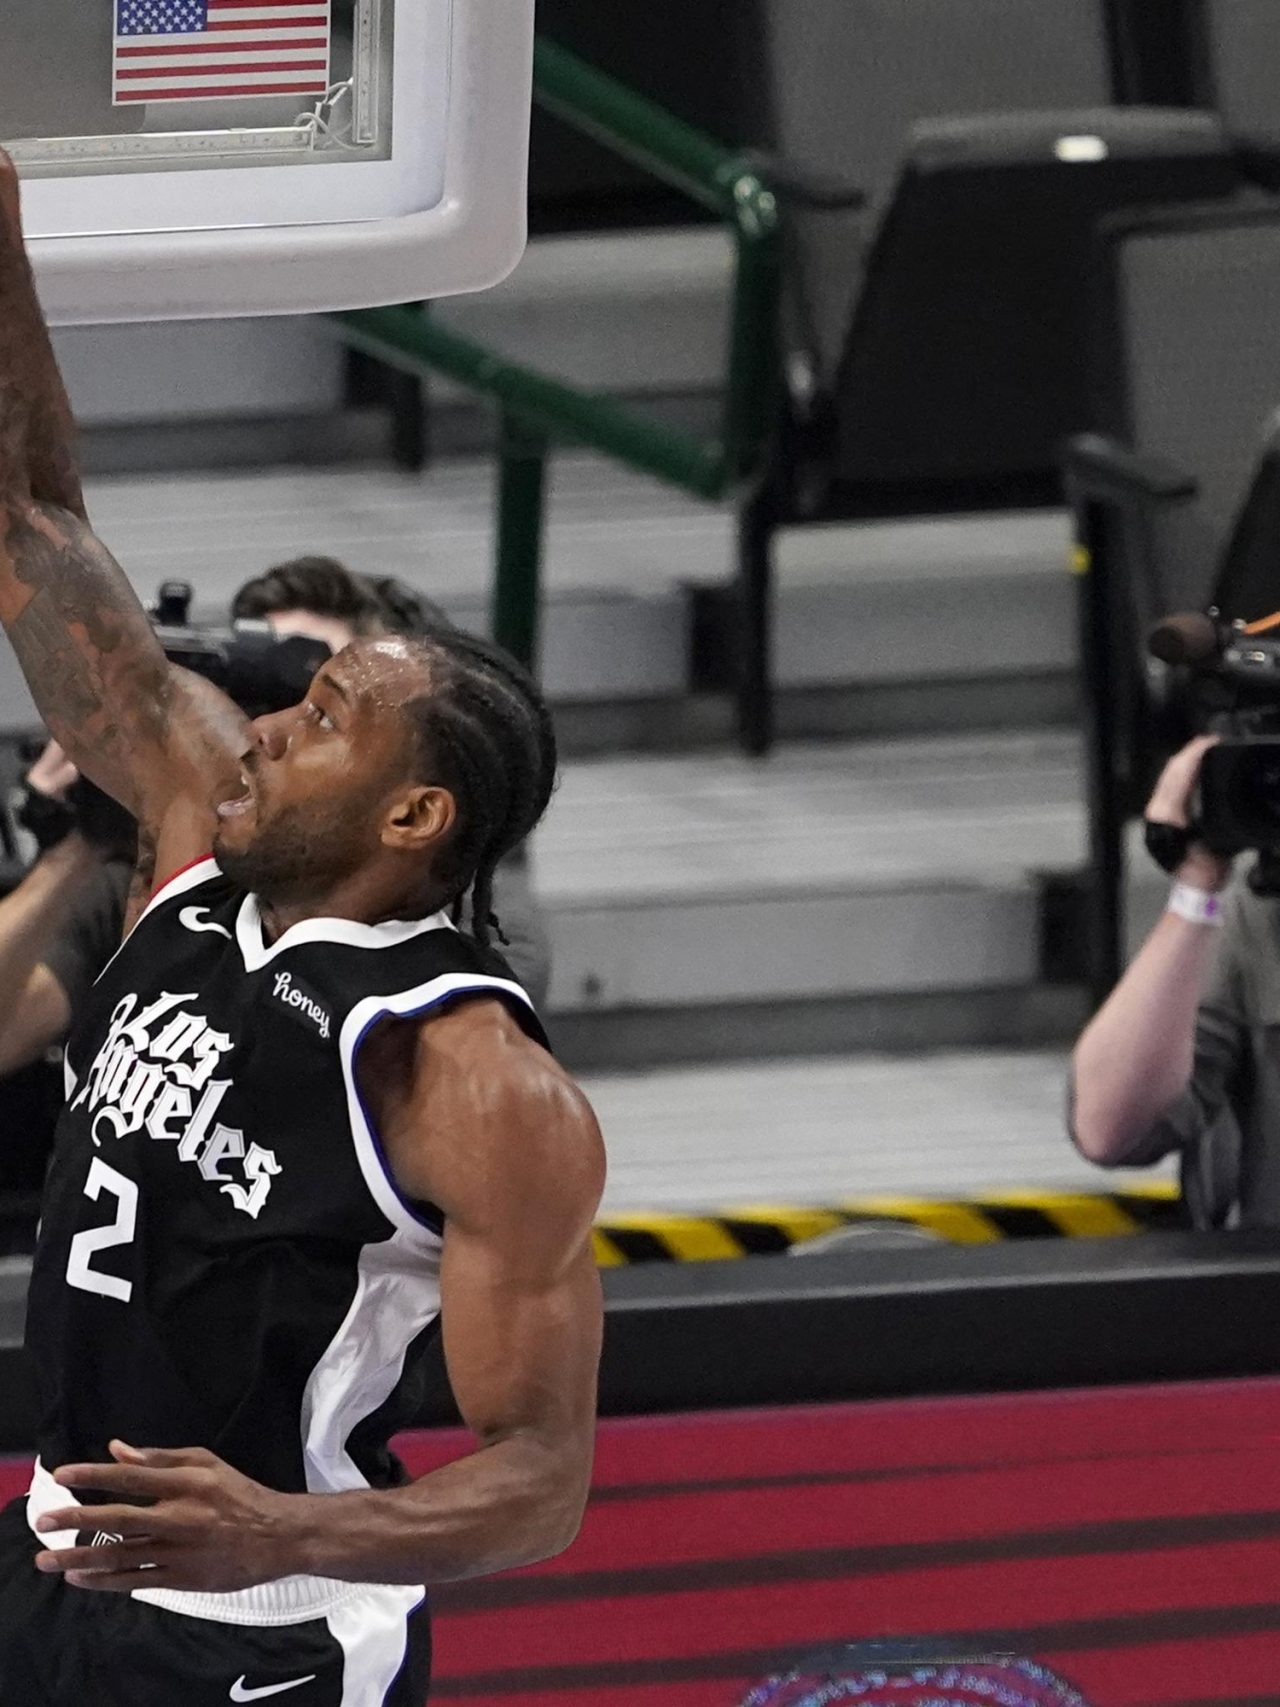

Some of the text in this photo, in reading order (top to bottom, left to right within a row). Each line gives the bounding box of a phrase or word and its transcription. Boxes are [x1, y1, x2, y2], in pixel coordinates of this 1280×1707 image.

[273, 971, 331, 1038] honey
[70, 1022, 283, 1219] Angeles
[66, 1156, 139, 1303] 2
